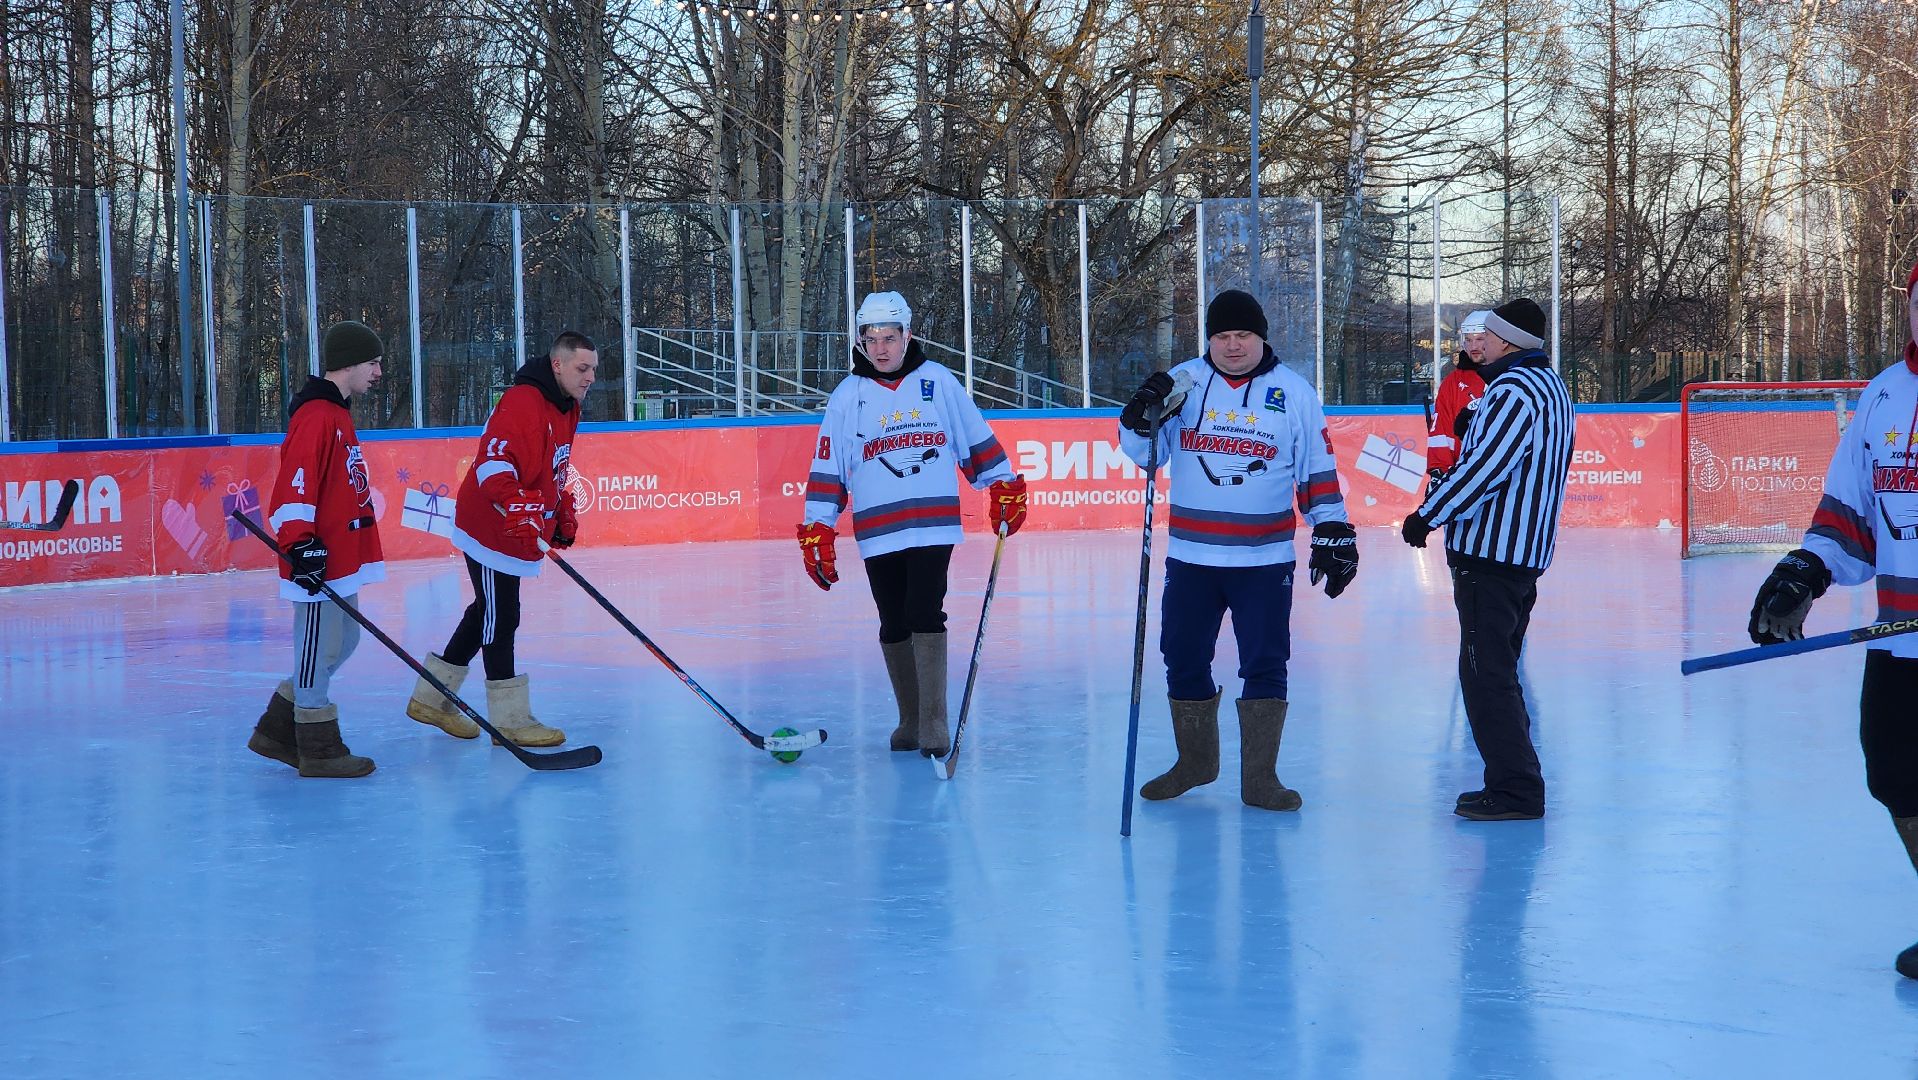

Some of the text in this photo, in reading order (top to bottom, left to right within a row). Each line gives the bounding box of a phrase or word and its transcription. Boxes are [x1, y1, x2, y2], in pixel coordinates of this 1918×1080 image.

[1212, 425, 1275, 440] ХОККЕЙНЫЙ КЛУБ
[486, 438, 508, 457] 11
[1572, 450, 1606, 464] ЕСЬ
[1732, 456, 1798, 472] ПАРКИ
[291, 467, 305, 495] 4
[598, 475, 658, 492] ПАРКИ
[1732, 476, 1825, 493] ПОДМОС
[0, 475, 122, 526] ИМА
[598, 491, 741, 513] ПОДМОСКОВЬЯ
[999, 492, 1026, 504] CC
[1034, 489, 1171, 507] ПОДМОСКОЬ
[0, 535, 122, 561] ОДМОСКОВЬЕ
[1312, 536, 1357, 547] BAUER
[303, 548, 328, 558] BAU
